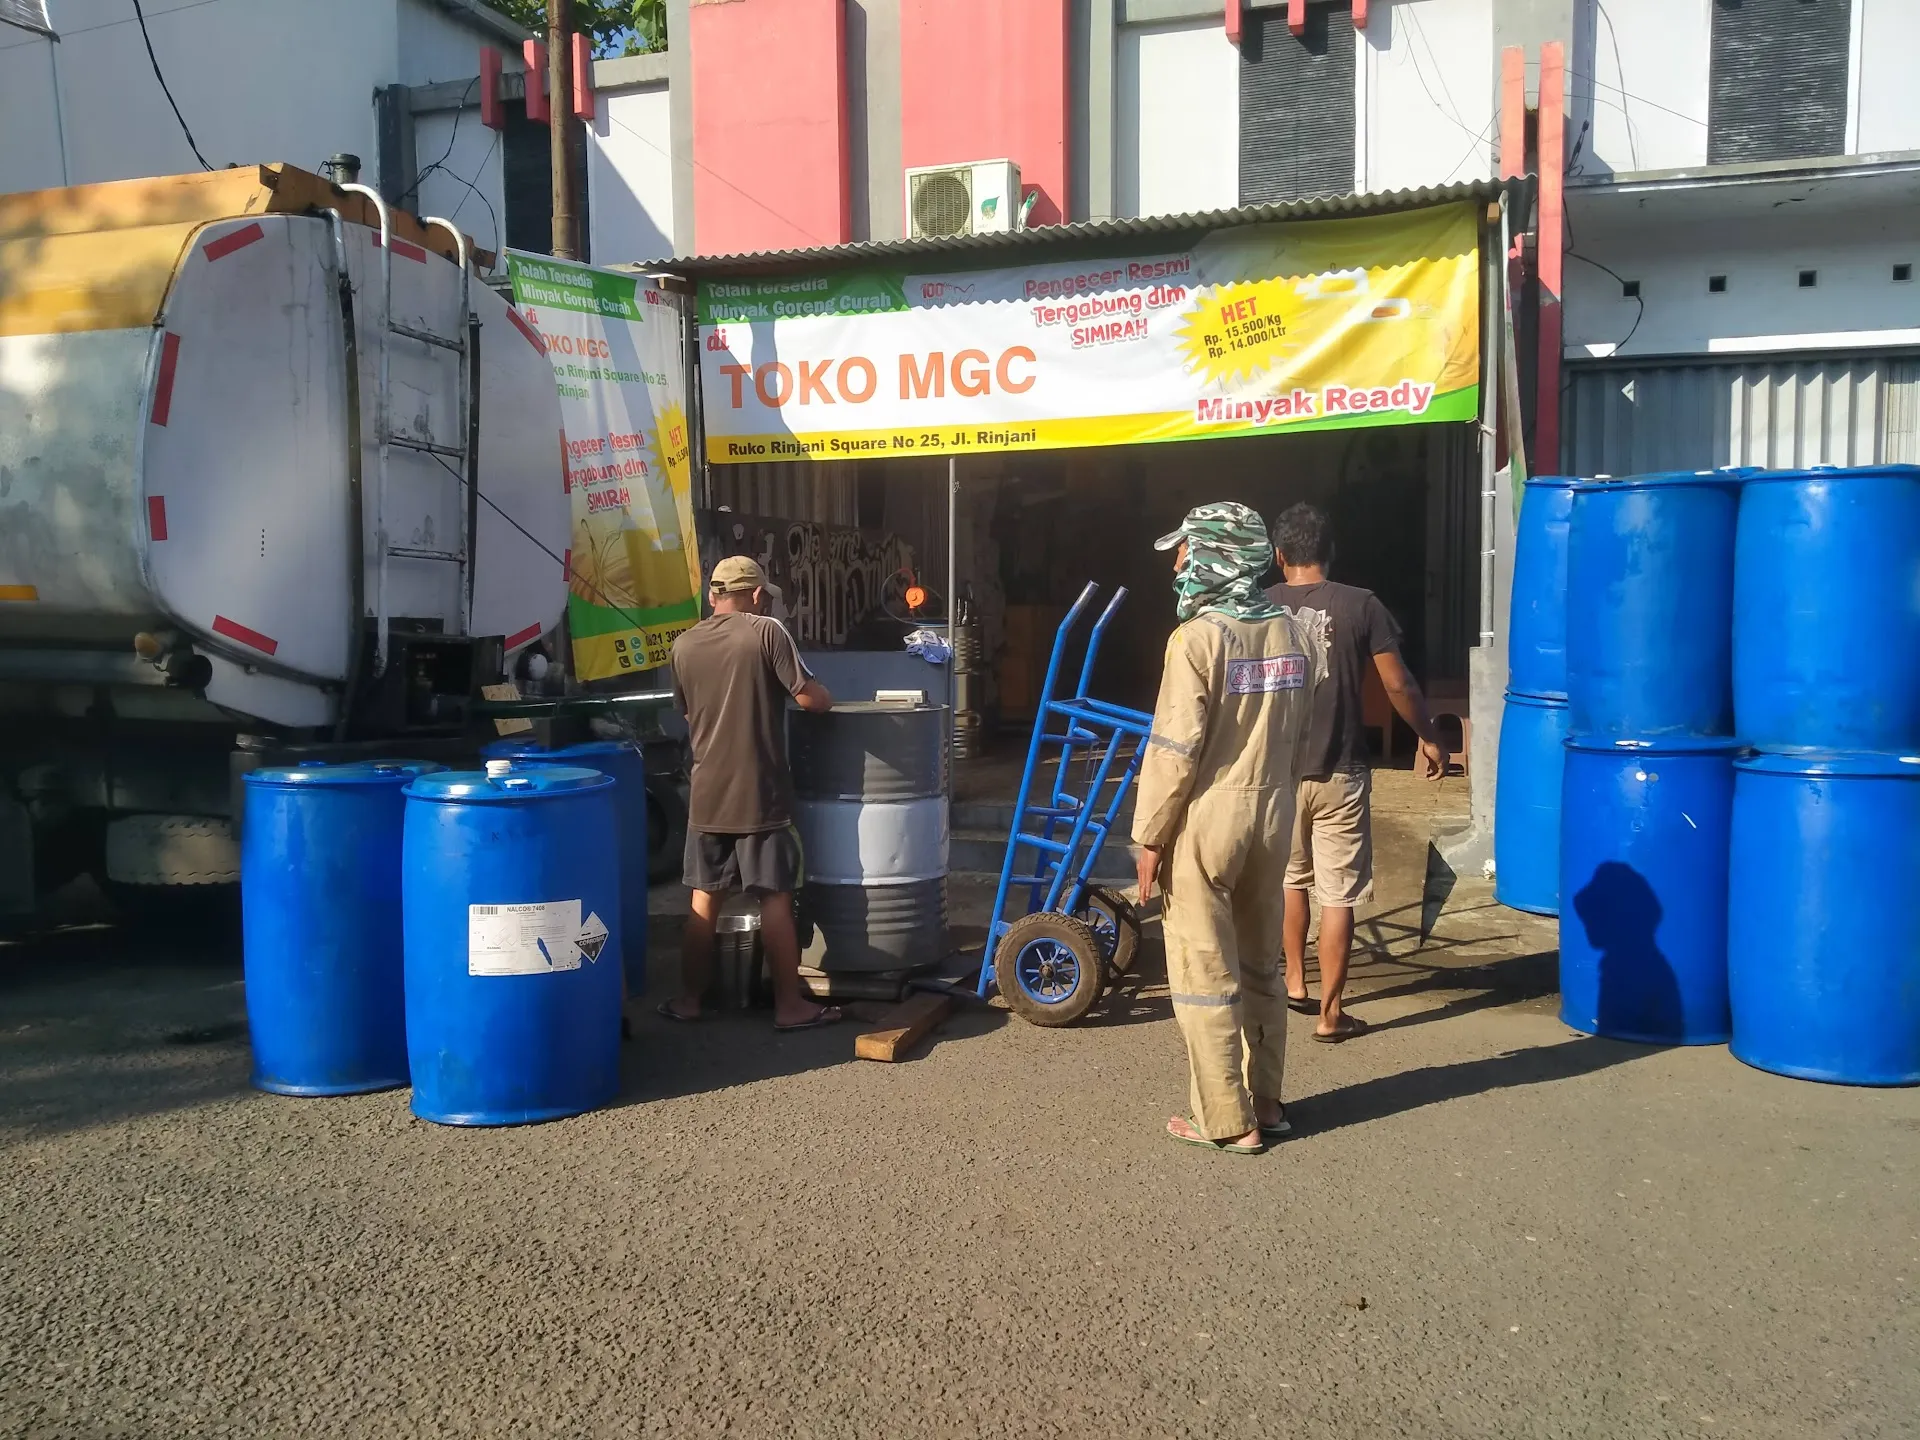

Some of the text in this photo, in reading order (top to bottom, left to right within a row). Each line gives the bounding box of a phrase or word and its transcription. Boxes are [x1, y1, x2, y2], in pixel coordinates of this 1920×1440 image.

[517, 262, 593, 289] Telah Tersedia
[707, 277, 828, 298] Telah Tersedia
[1025, 256, 1190, 298] Pengecer Resmi
[521, 283, 560, 304] Minyak
[563, 290, 601, 312] Goreng
[602, 297, 631, 315] Curah
[709, 292, 892, 320] Minyak Goreng Curah
[1033, 285, 1186, 325] Tergabung dlm
[1220, 296, 1257, 325] HET
[542, 333, 573, 355] OKO
[706, 329, 730, 351] di
[1072, 318, 1148, 347] SIMIRAH
[1203, 314, 1282, 347] Rp. 15.500/Kg
[1208, 325, 1287, 359] Rp. 14.000/Ltr
[603, 368, 640, 386] Square
[642, 371, 655, 384] No
[719, 346, 1037, 409] TOKO MGC
[1197, 382, 1431, 423] Minyak Ready
[608, 430, 645, 450] Resmi
[728, 443, 766, 456] Ruko
[770, 438, 825, 457] Rinjani
[830, 437, 887, 454] Square
[893, 436, 915, 449] No
[920, 433, 945, 451] 25,
[977, 428, 1037, 446] Rinjani
[569, 464, 623, 487] ergabung
[587, 487, 631, 511] SIMIRAH
